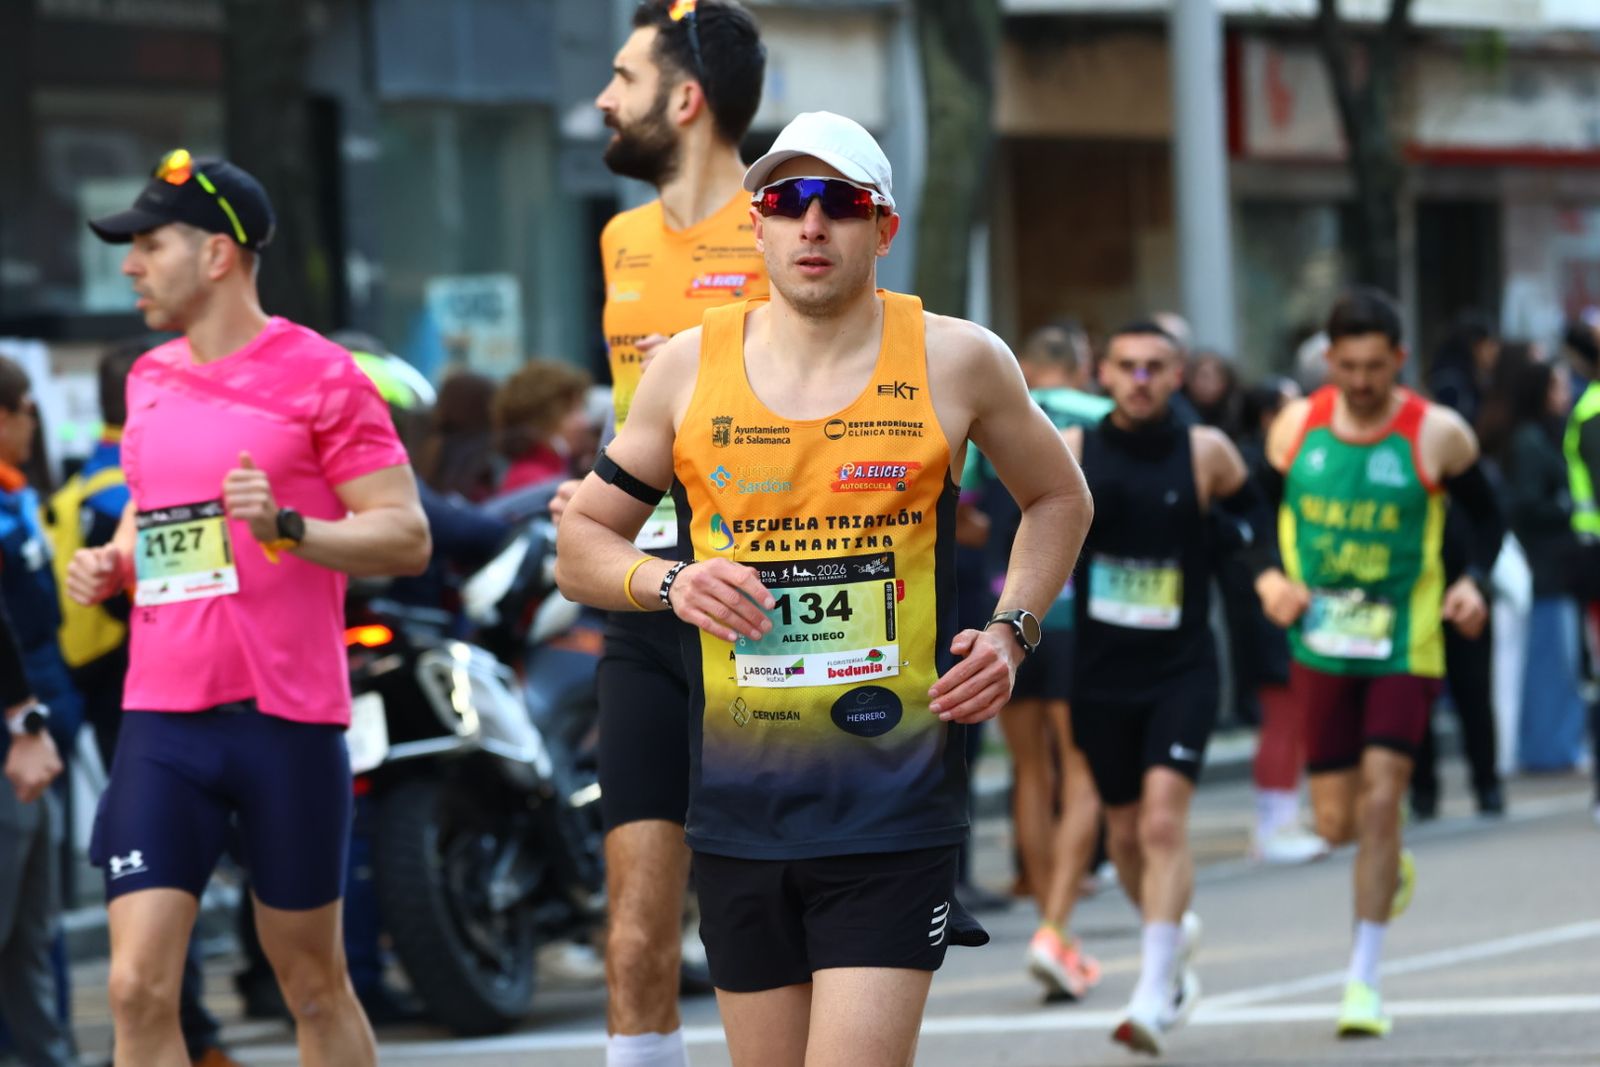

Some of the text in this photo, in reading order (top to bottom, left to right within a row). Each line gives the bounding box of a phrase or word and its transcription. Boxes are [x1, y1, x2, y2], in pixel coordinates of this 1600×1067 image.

[848, 420, 924, 429] ESTER RODRÍGUEZ
[734, 426, 790, 436] Ayuntamiento
[848, 429, 924, 437] CLÍNICA DENTAL
[734, 436, 791, 444] de Salamanca
[733, 509, 922, 533] ESCUELA TRIATLÓN
[750, 535, 893, 552] SALMANTINA
[817, 563, 847, 576] 2026
[773, 590, 853, 625] 134
[782, 631, 845, 643] ALEX DIEGO
[744, 666, 784, 675] LABORAL
[827, 663, 883, 679] bedunia
[752, 710, 800, 721] CERVISÁN
[846, 711, 886, 722] HERRERO
